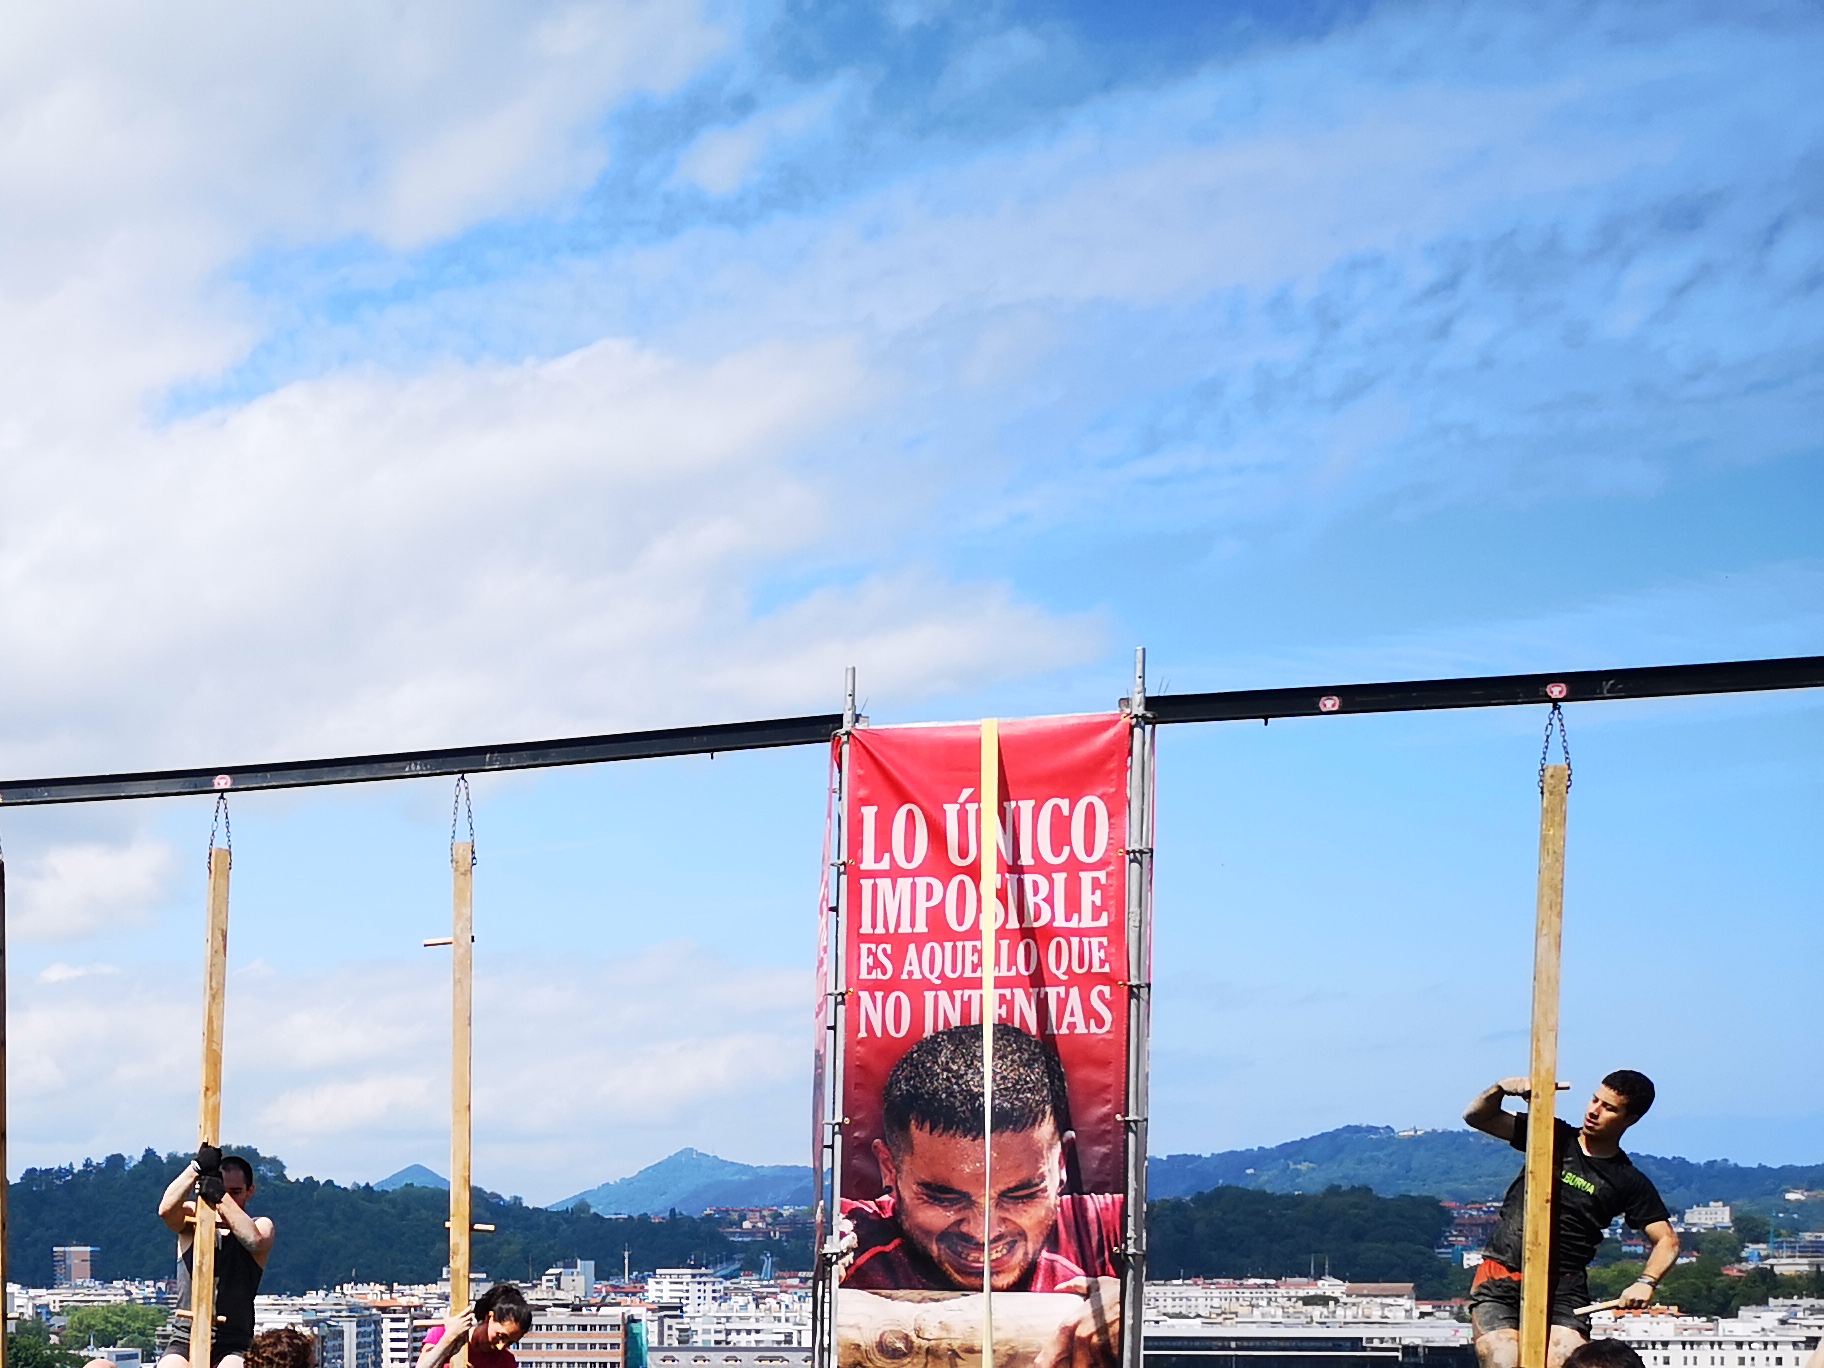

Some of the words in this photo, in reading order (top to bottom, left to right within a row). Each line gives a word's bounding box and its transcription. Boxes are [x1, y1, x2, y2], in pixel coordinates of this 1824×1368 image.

[860, 803, 928, 870] LO
[943, 788, 1109, 866] ÚNICO
[859, 943, 893, 980] ES
[900, 938, 1038, 984] AQUELO
[1047, 936, 1110, 980] QUE
[857, 990, 911, 1038] NO
[923, 985, 1113, 1037] INTENTAS
